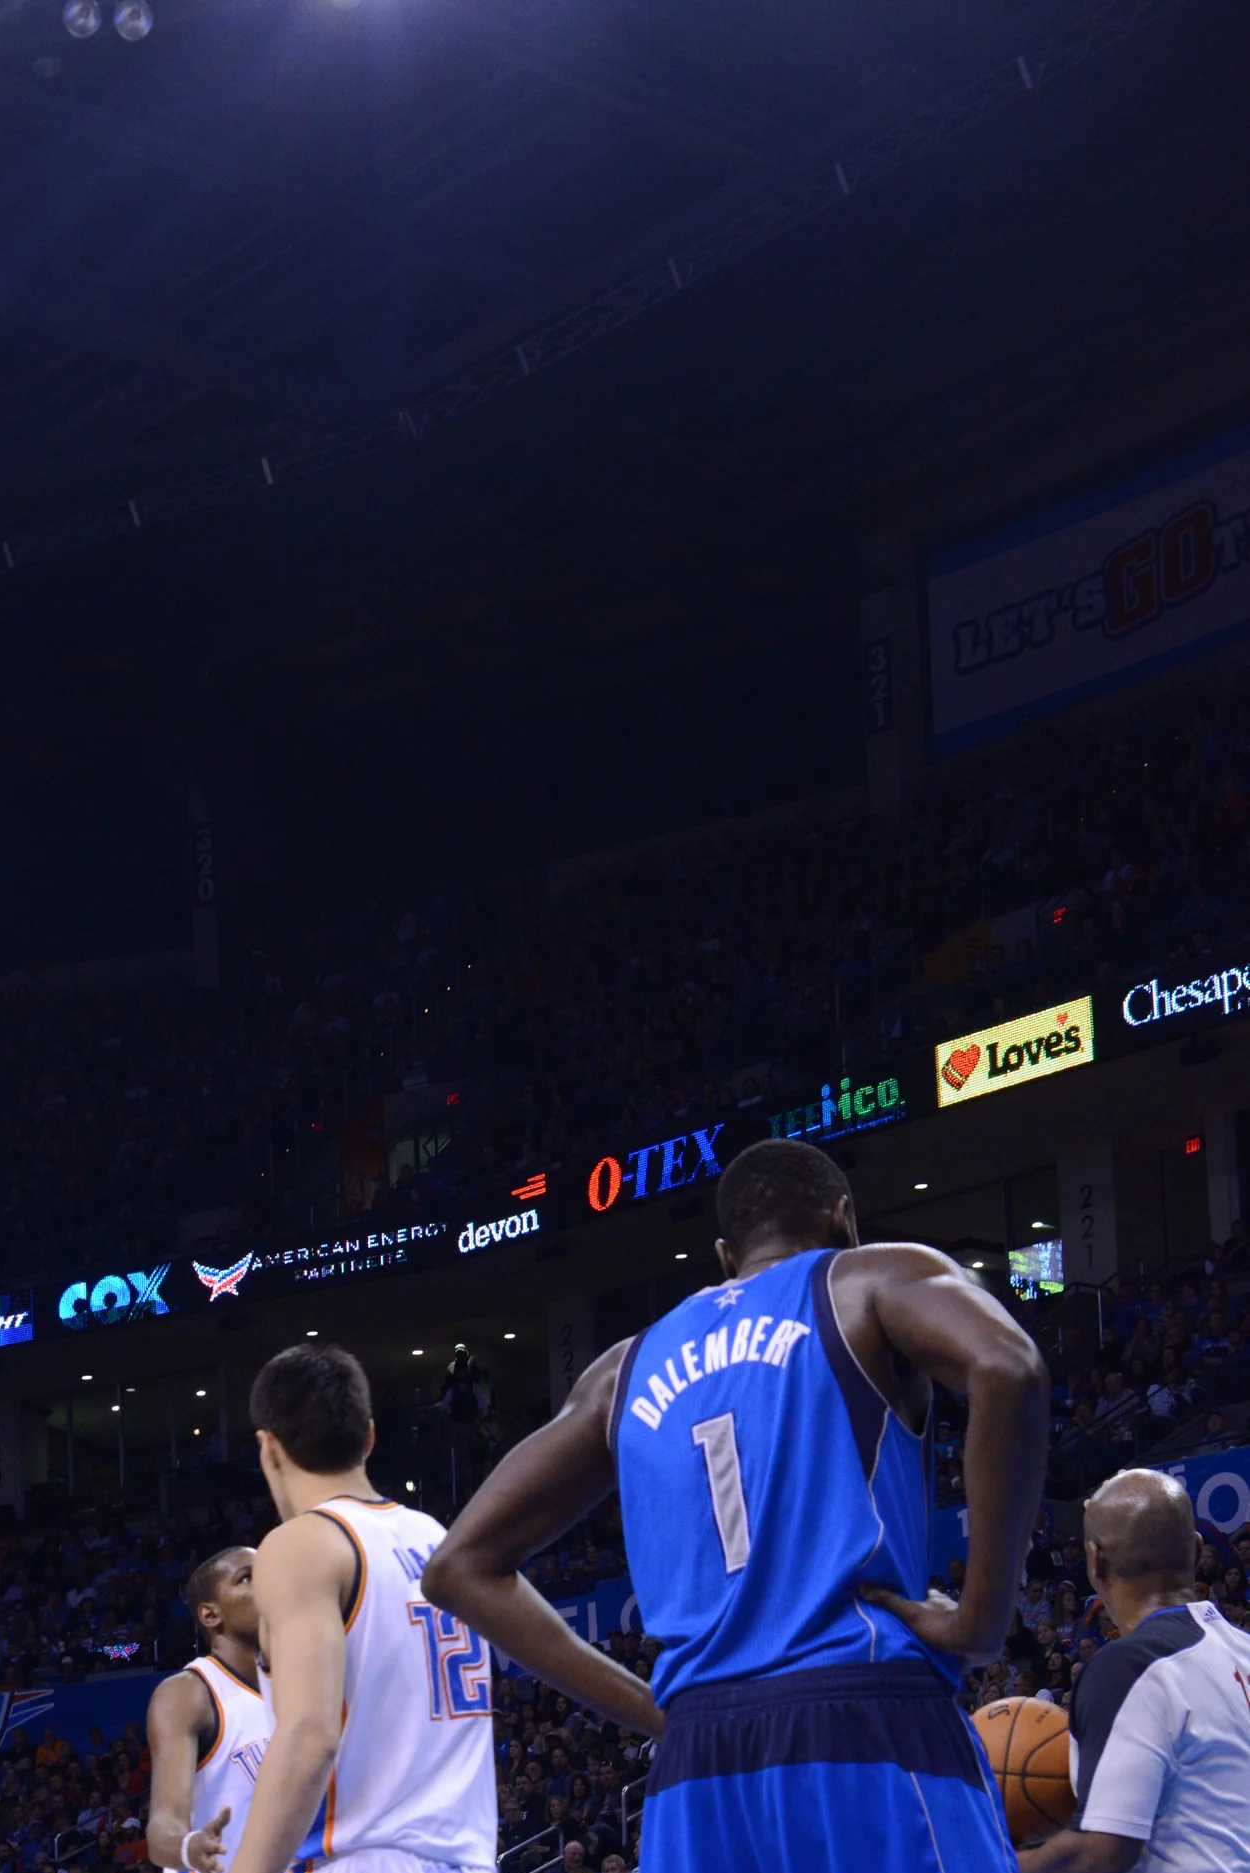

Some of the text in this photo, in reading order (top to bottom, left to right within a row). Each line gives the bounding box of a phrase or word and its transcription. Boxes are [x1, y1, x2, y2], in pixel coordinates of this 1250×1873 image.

[953, 570, 1107, 676] LET'S
[1102, 498, 1217, 640] GO
[868, 644, 890, 728] 321
[196, 827, 215, 901] 320
[588, 1120, 726, 1212] O-TEX
[251, 1238, 360, 1272] AMERICAN
[458, 1208, 540, 1253] devon
[1080, 1184, 1094, 1267] 221
[58, 1261, 171, 1331] COX
[630, 1316, 812, 1432] DALEMBERT
[691, 1410, 751, 1575] 1
[406, 1602, 493, 1721] 12
